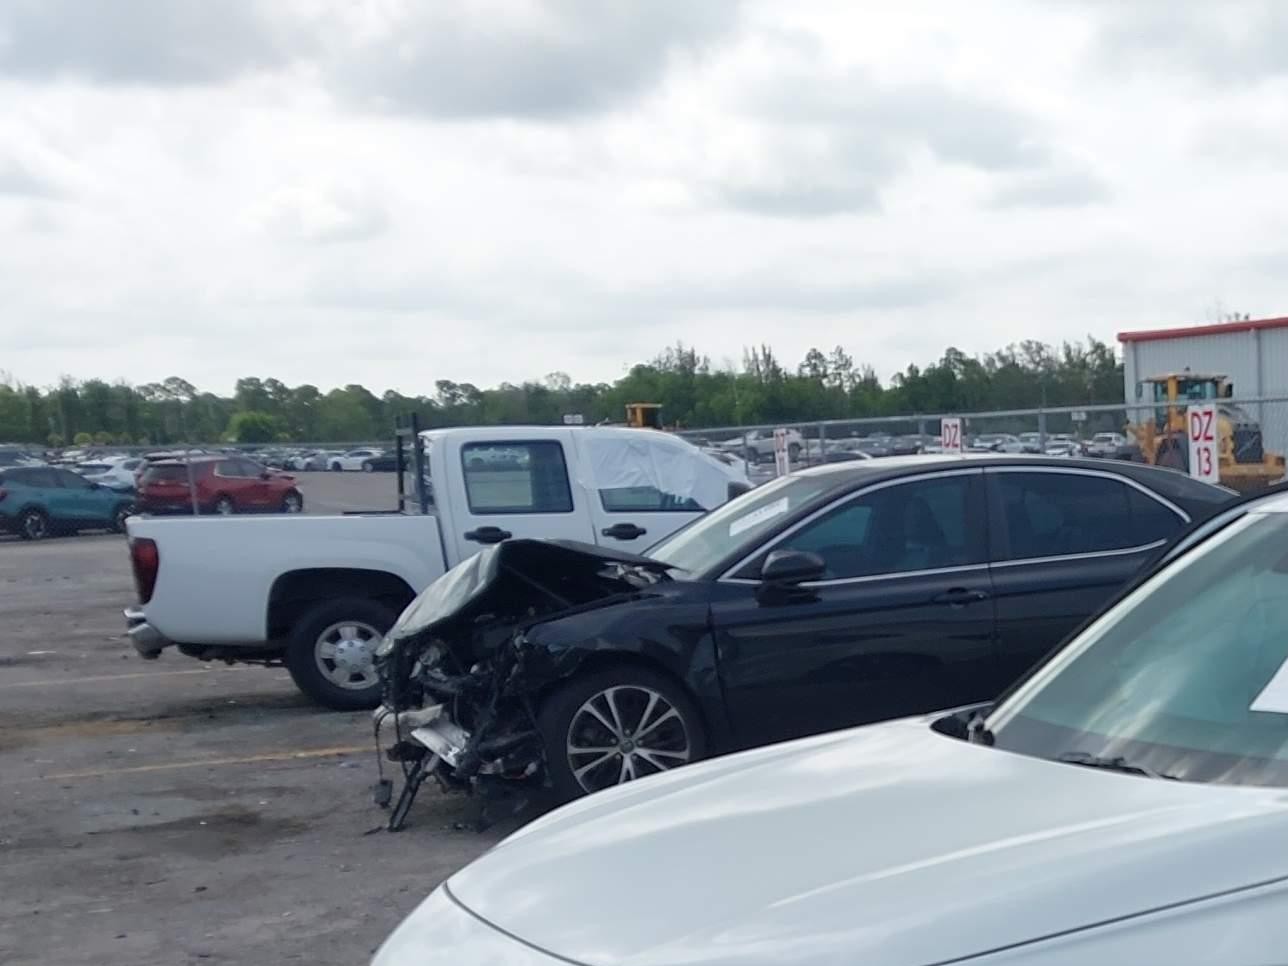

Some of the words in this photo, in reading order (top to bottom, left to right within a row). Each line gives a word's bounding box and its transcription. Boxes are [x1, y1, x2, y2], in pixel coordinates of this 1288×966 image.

[943, 423, 960, 449] DZ
[1191, 411, 1213, 442] DZ
[1197, 446, 1212, 476] 13
